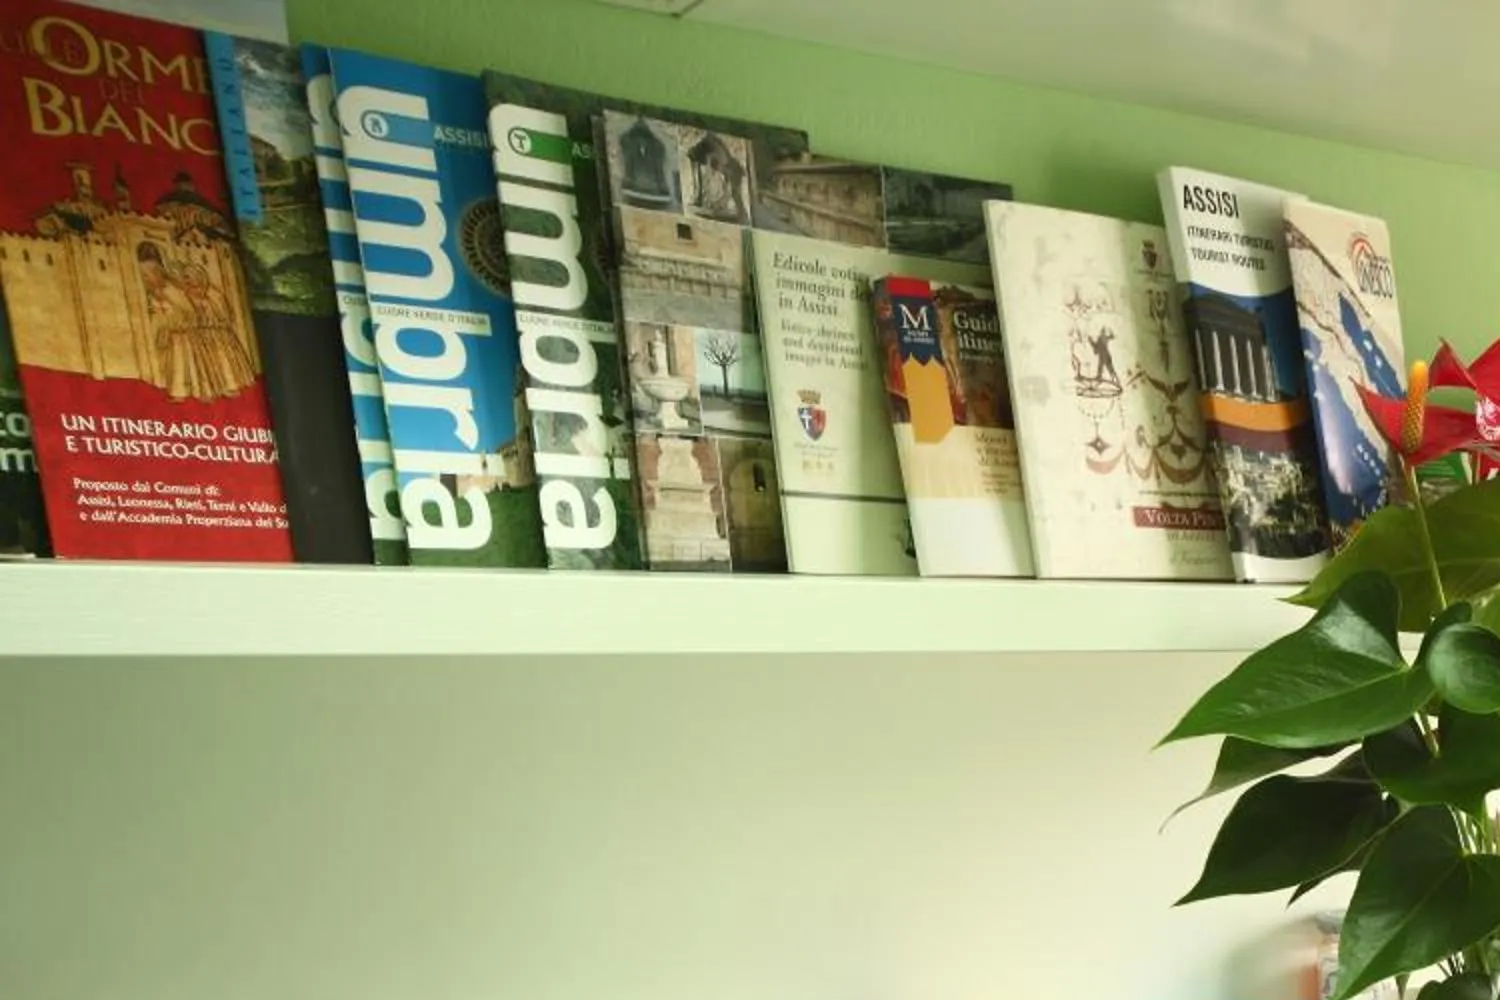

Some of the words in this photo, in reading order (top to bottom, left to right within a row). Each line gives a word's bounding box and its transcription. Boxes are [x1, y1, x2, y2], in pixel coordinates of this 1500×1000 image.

[1183, 184, 1240, 219] ASSISI
[773, 252, 827, 276] Edicole
[776, 272, 846, 301] immagini
[779, 292, 793, 309] in
[798, 295, 839, 316] Assisi
[61, 414, 95, 431] UN
[102, 416, 217, 440] ITINERARIO
[65, 435, 79, 453] E
[73, 478, 128, 494] Proposto
[79, 512, 87, 521] e
